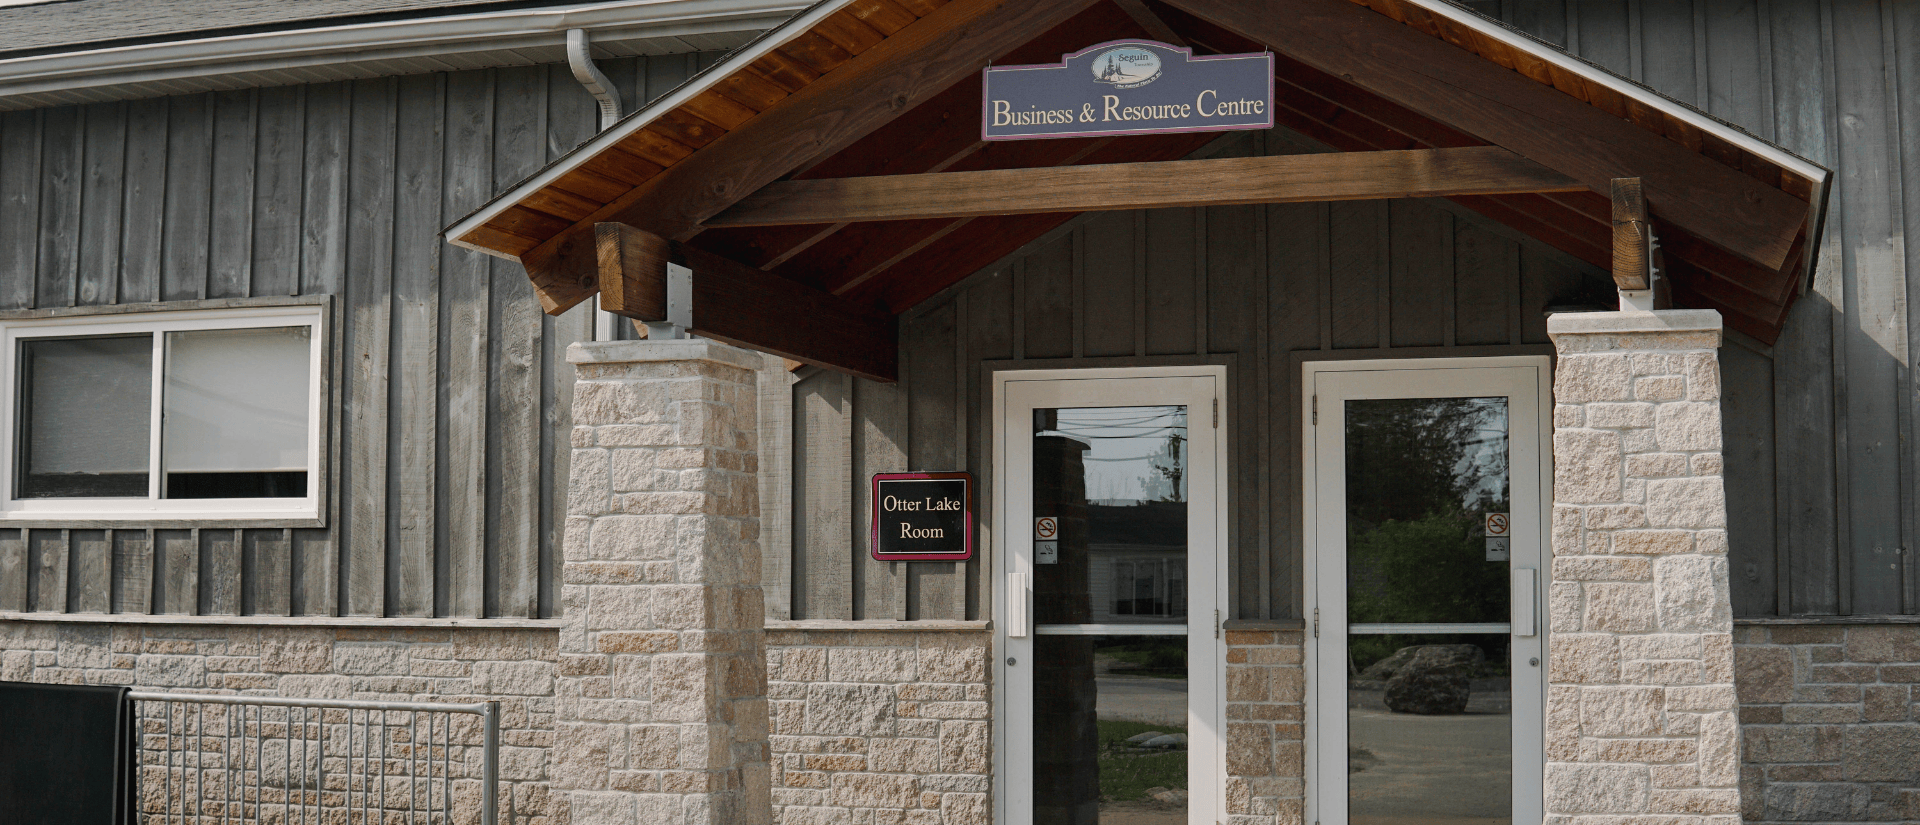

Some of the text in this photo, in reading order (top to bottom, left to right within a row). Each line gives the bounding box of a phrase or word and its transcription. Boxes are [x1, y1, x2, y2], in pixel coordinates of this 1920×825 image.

[1118, 53, 1149, 63] Seguin
[992, 89, 1265, 127] Business & Resource Centre
[883, 495, 961, 511] Otter Lake
[900, 522, 944, 539] Room
